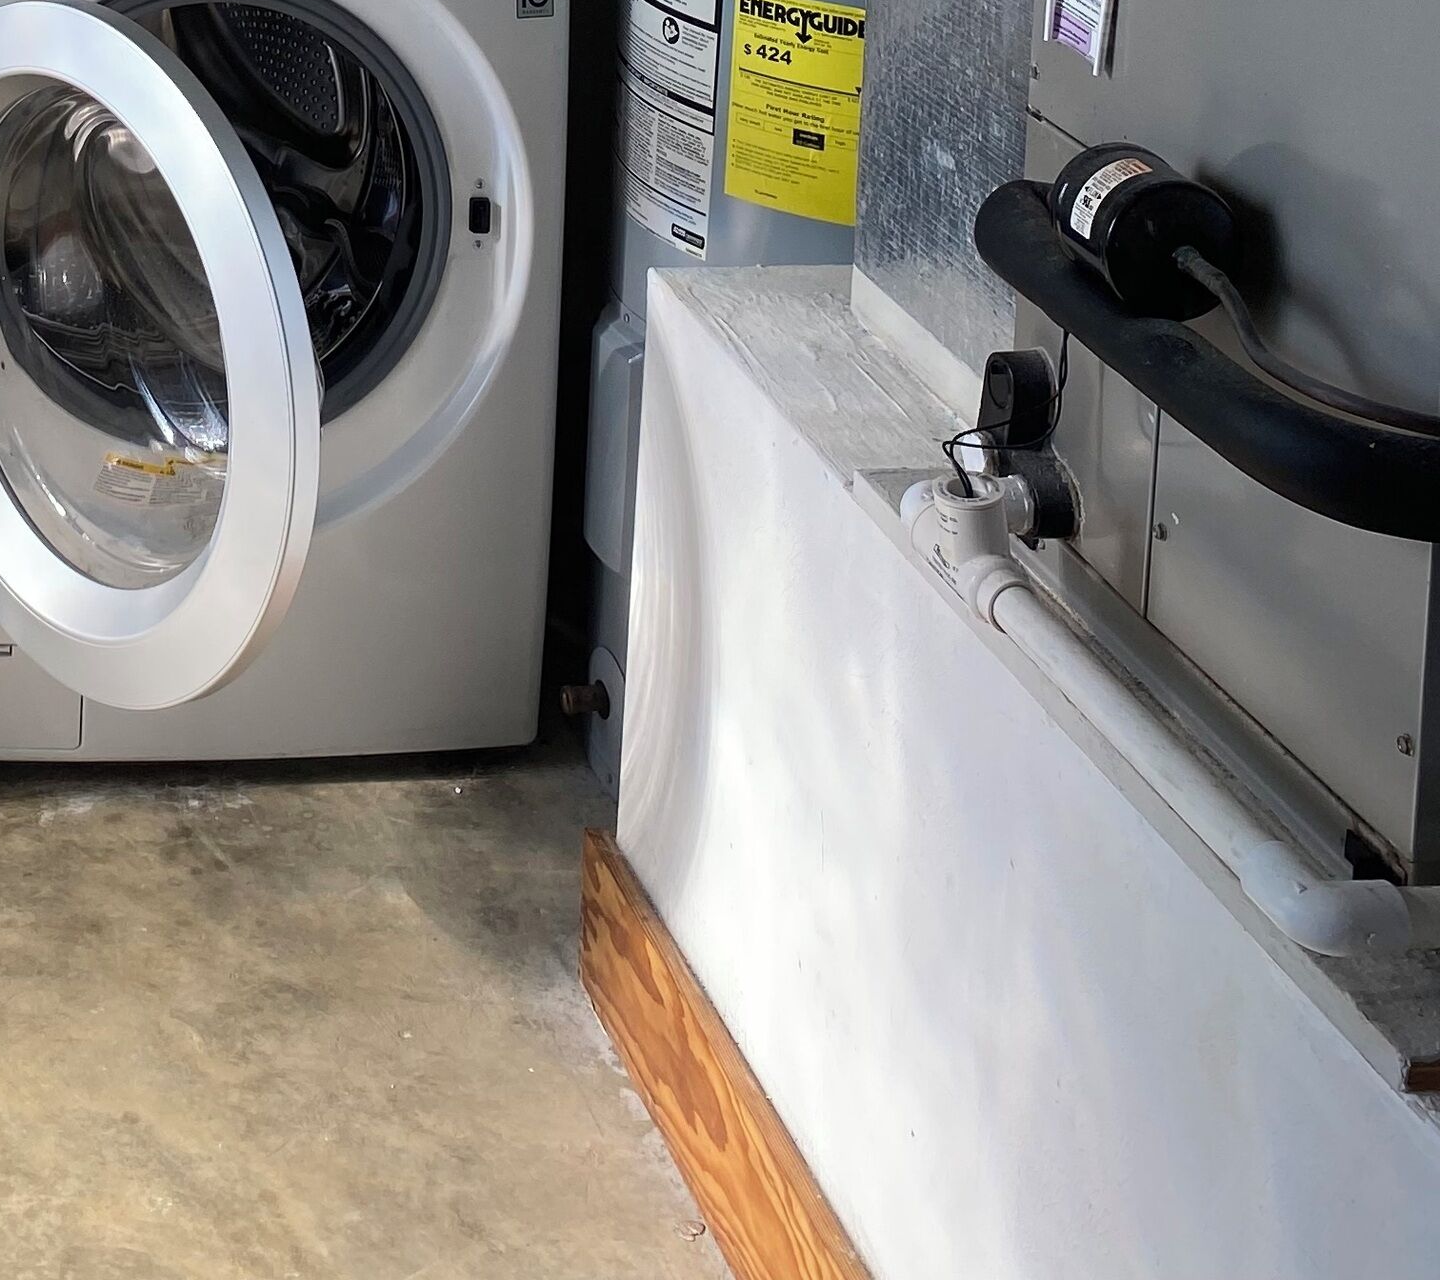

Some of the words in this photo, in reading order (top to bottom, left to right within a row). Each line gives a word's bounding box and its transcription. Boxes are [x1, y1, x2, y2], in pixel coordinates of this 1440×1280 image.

[744, 43, 752, 56] $
[756, 44, 792, 65] 424
[801, 112, 825, 124] Rating
